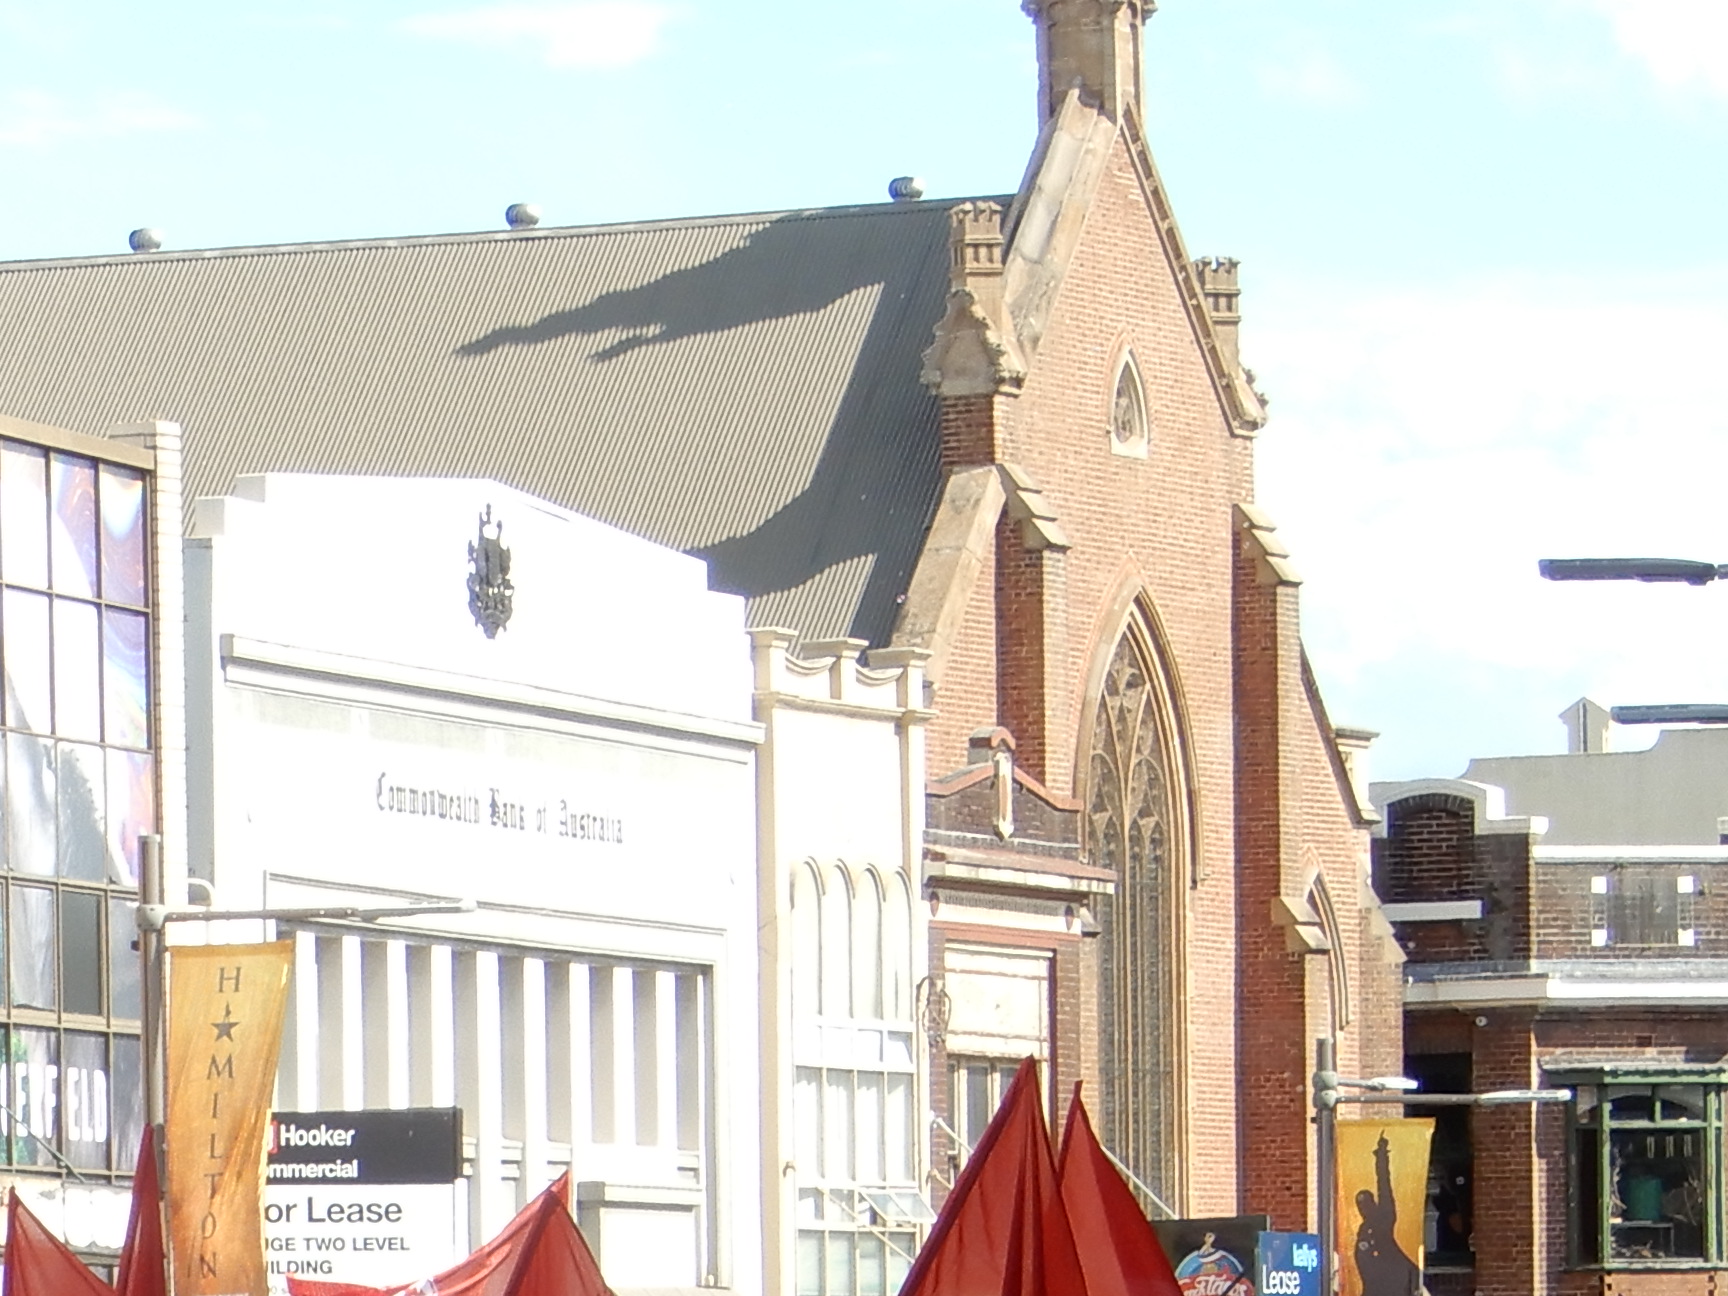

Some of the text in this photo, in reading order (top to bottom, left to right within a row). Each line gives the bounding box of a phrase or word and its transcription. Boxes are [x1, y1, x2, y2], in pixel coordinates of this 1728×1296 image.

[280, 1124, 355, 1147] Hooker
[267, 1159, 359, 1178] mmercial
[264, 1196, 402, 1224] or Lease
[265, 1236, 410, 1252] GE TWO LEVEL
[265, 1259, 333, 1275] ILDING
[1262, 1264, 1301, 1295] Lease
